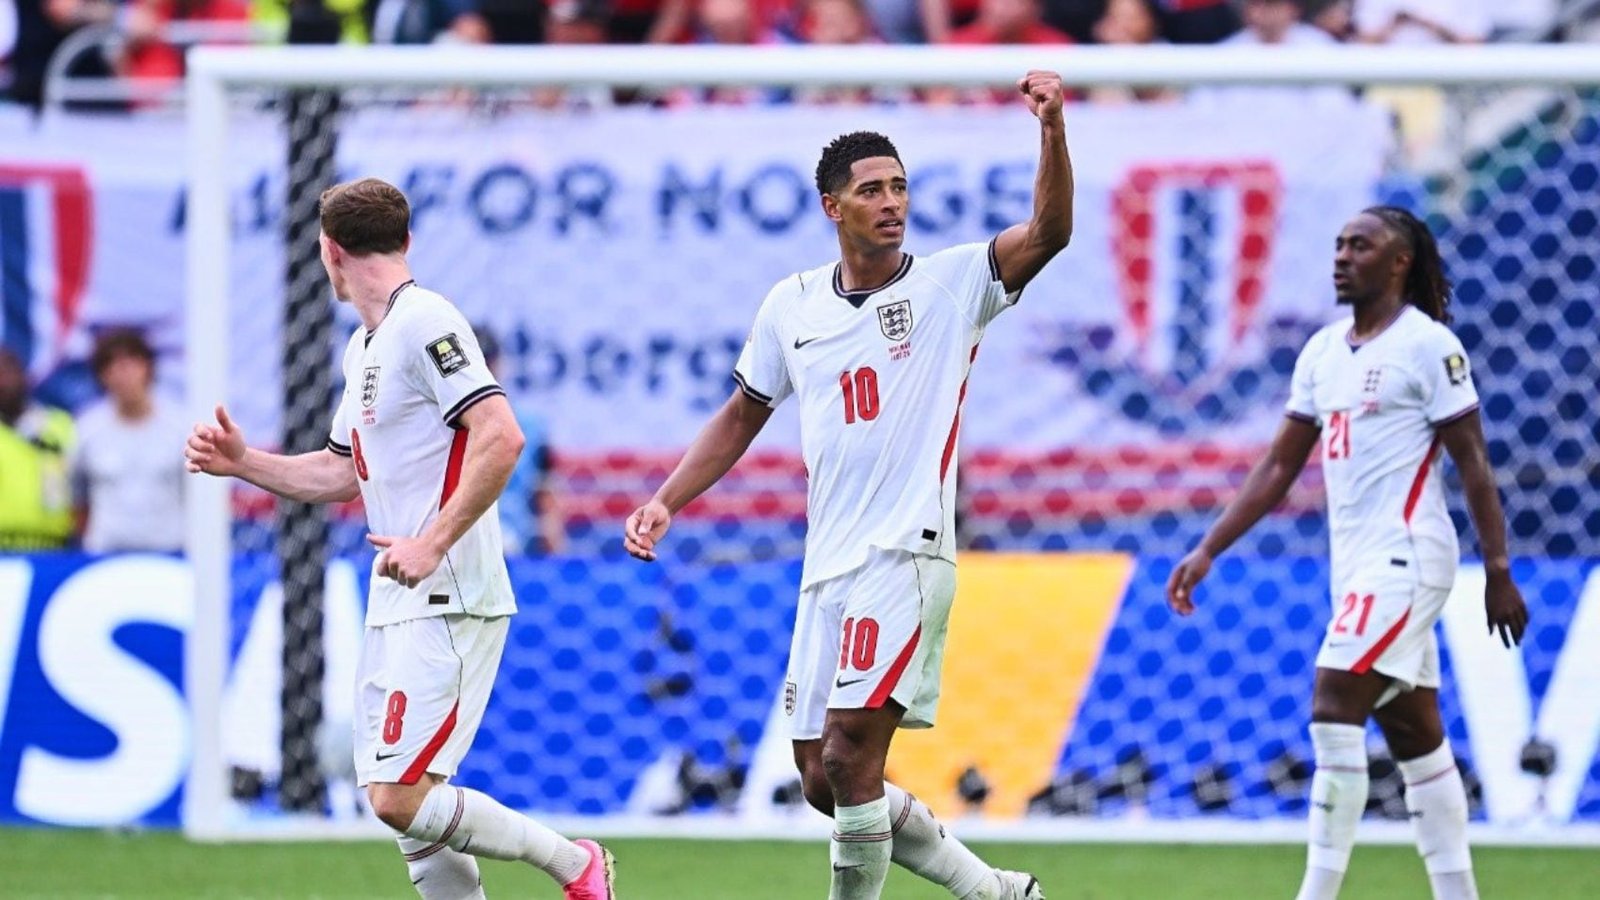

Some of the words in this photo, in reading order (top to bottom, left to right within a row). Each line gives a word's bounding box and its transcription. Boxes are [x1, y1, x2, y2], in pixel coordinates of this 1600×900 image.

[408, 164, 614, 235] FOR
[658, 164, 1035, 235] NOGE
[509, 322, 742, 410] berg
[839, 366, 880, 425] 10
[1328, 410, 1350, 460] 21
[1335, 593, 1374, 636] 21
[840, 617, 880, 671] 10
[383, 690, 408, 745] 8
